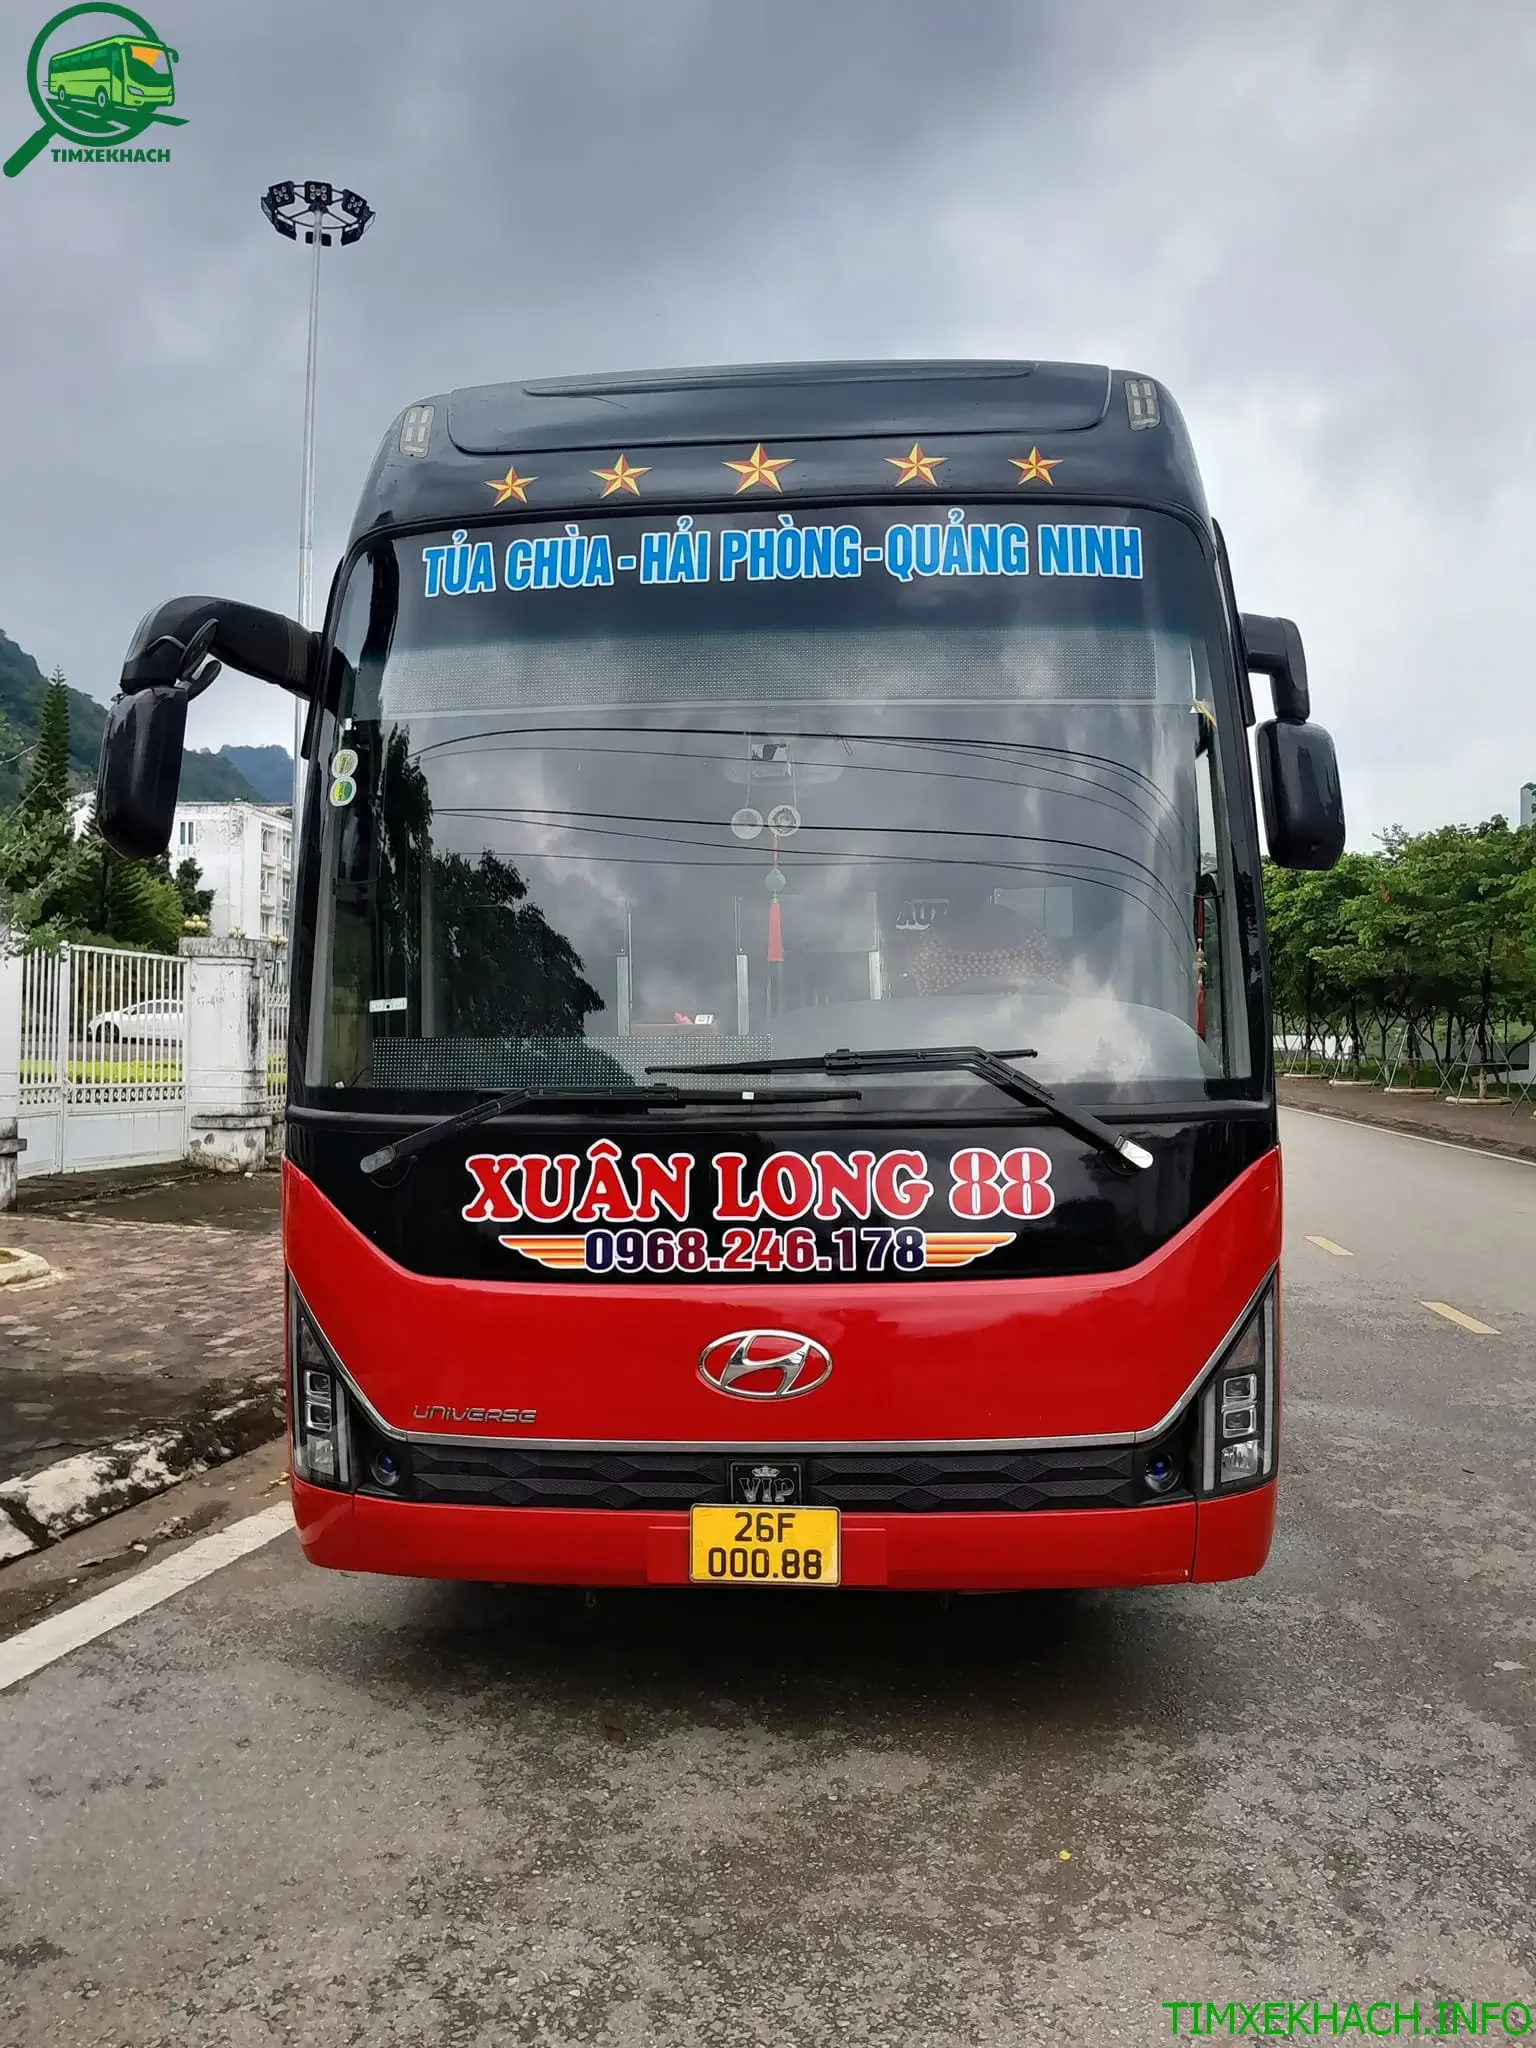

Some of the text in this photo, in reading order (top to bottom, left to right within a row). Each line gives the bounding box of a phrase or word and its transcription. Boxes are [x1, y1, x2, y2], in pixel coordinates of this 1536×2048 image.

[423, 529, 496, 597] TỦA
[1038, 524, 1143, 579] NINH
[462, 1138, 1054, 1223] XUÂN LONG 88
[583, 1226, 927, 1273] 0968.246.178
[412, 1405, 537, 1424] UNIVERSE
[738, 1477, 796, 1503] VIP
[734, 1511, 796, 1543] 26F
[708, 1547, 823, 1580] 000.88
